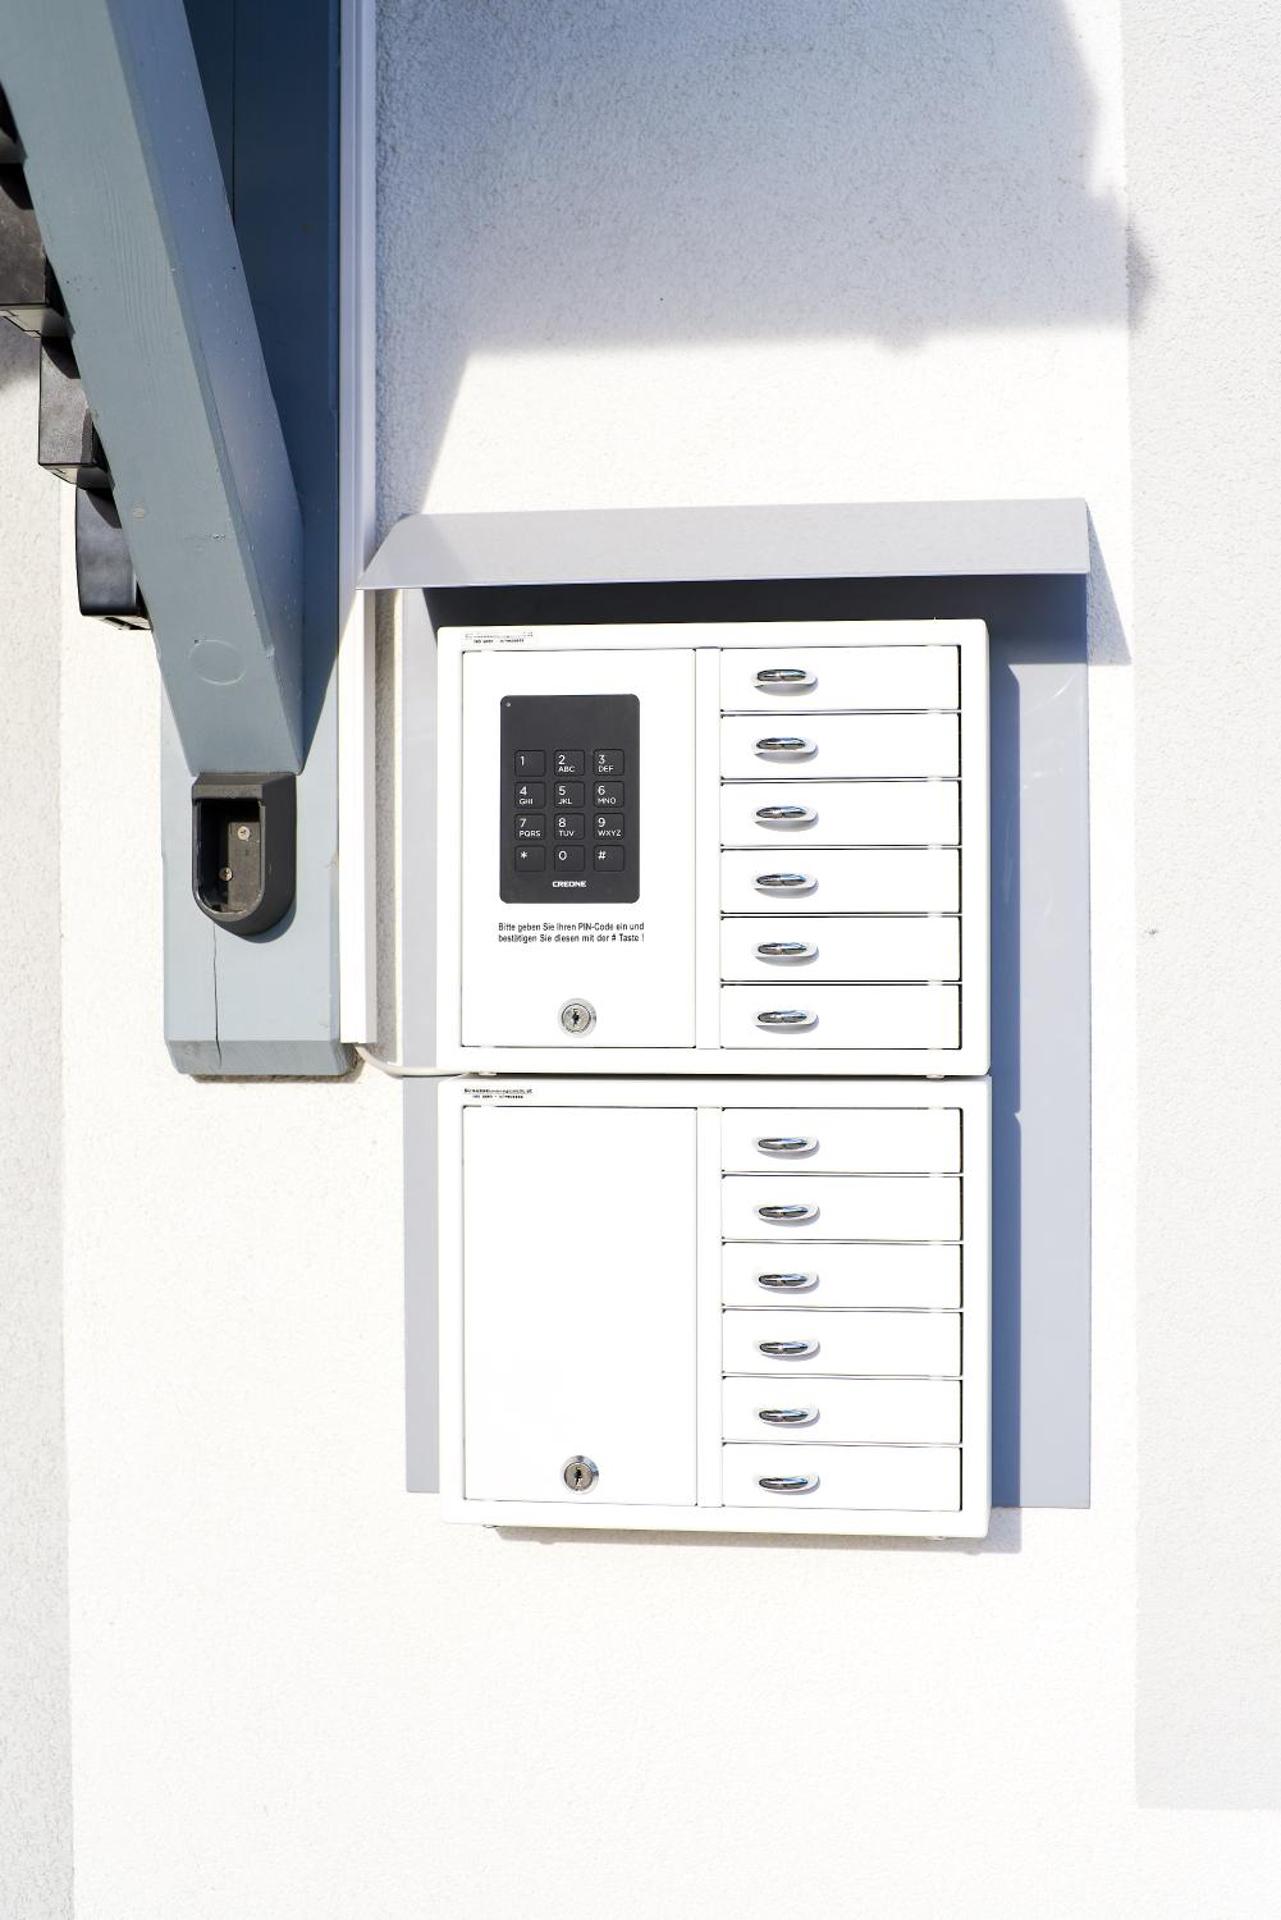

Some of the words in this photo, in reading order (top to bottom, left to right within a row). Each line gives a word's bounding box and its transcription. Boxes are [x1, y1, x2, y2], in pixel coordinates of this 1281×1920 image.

[520, 756, 525, 766] 1
[559, 755, 566, 765] 2
[599, 755, 606, 765] 3
[599, 765, 614, 773] DEF
[520, 786, 528, 796] 4
[559, 786, 567, 796] 5
[598, 786, 606, 796] 6
[598, 797, 617, 805] MNO
[520, 818, 527, 828] 7
[559, 818, 567, 828] 8
[598, 818, 607, 828] 9
[559, 851, 568, 861] 0
[598, 851, 607, 860] #
[552, 880, 587, 888] CREONE
[499, 922, 516, 931] Bitte
[518, 922, 541, 933] geben
[543, 922, 555, 931] Sie
[556, 922, 577, 931] Ihren
[578, 922, 614, 931] PIN-Code
[616, 922, 628, 931] ein
[629, 922, 644, 931] und
[540, 933, 553, 942] Sie
[554, 933, 580, 942] diesen
[581, 933, 595, 942] mit
[597, 933, 609, 942] der
[619, 933, 640, 942] Taste
